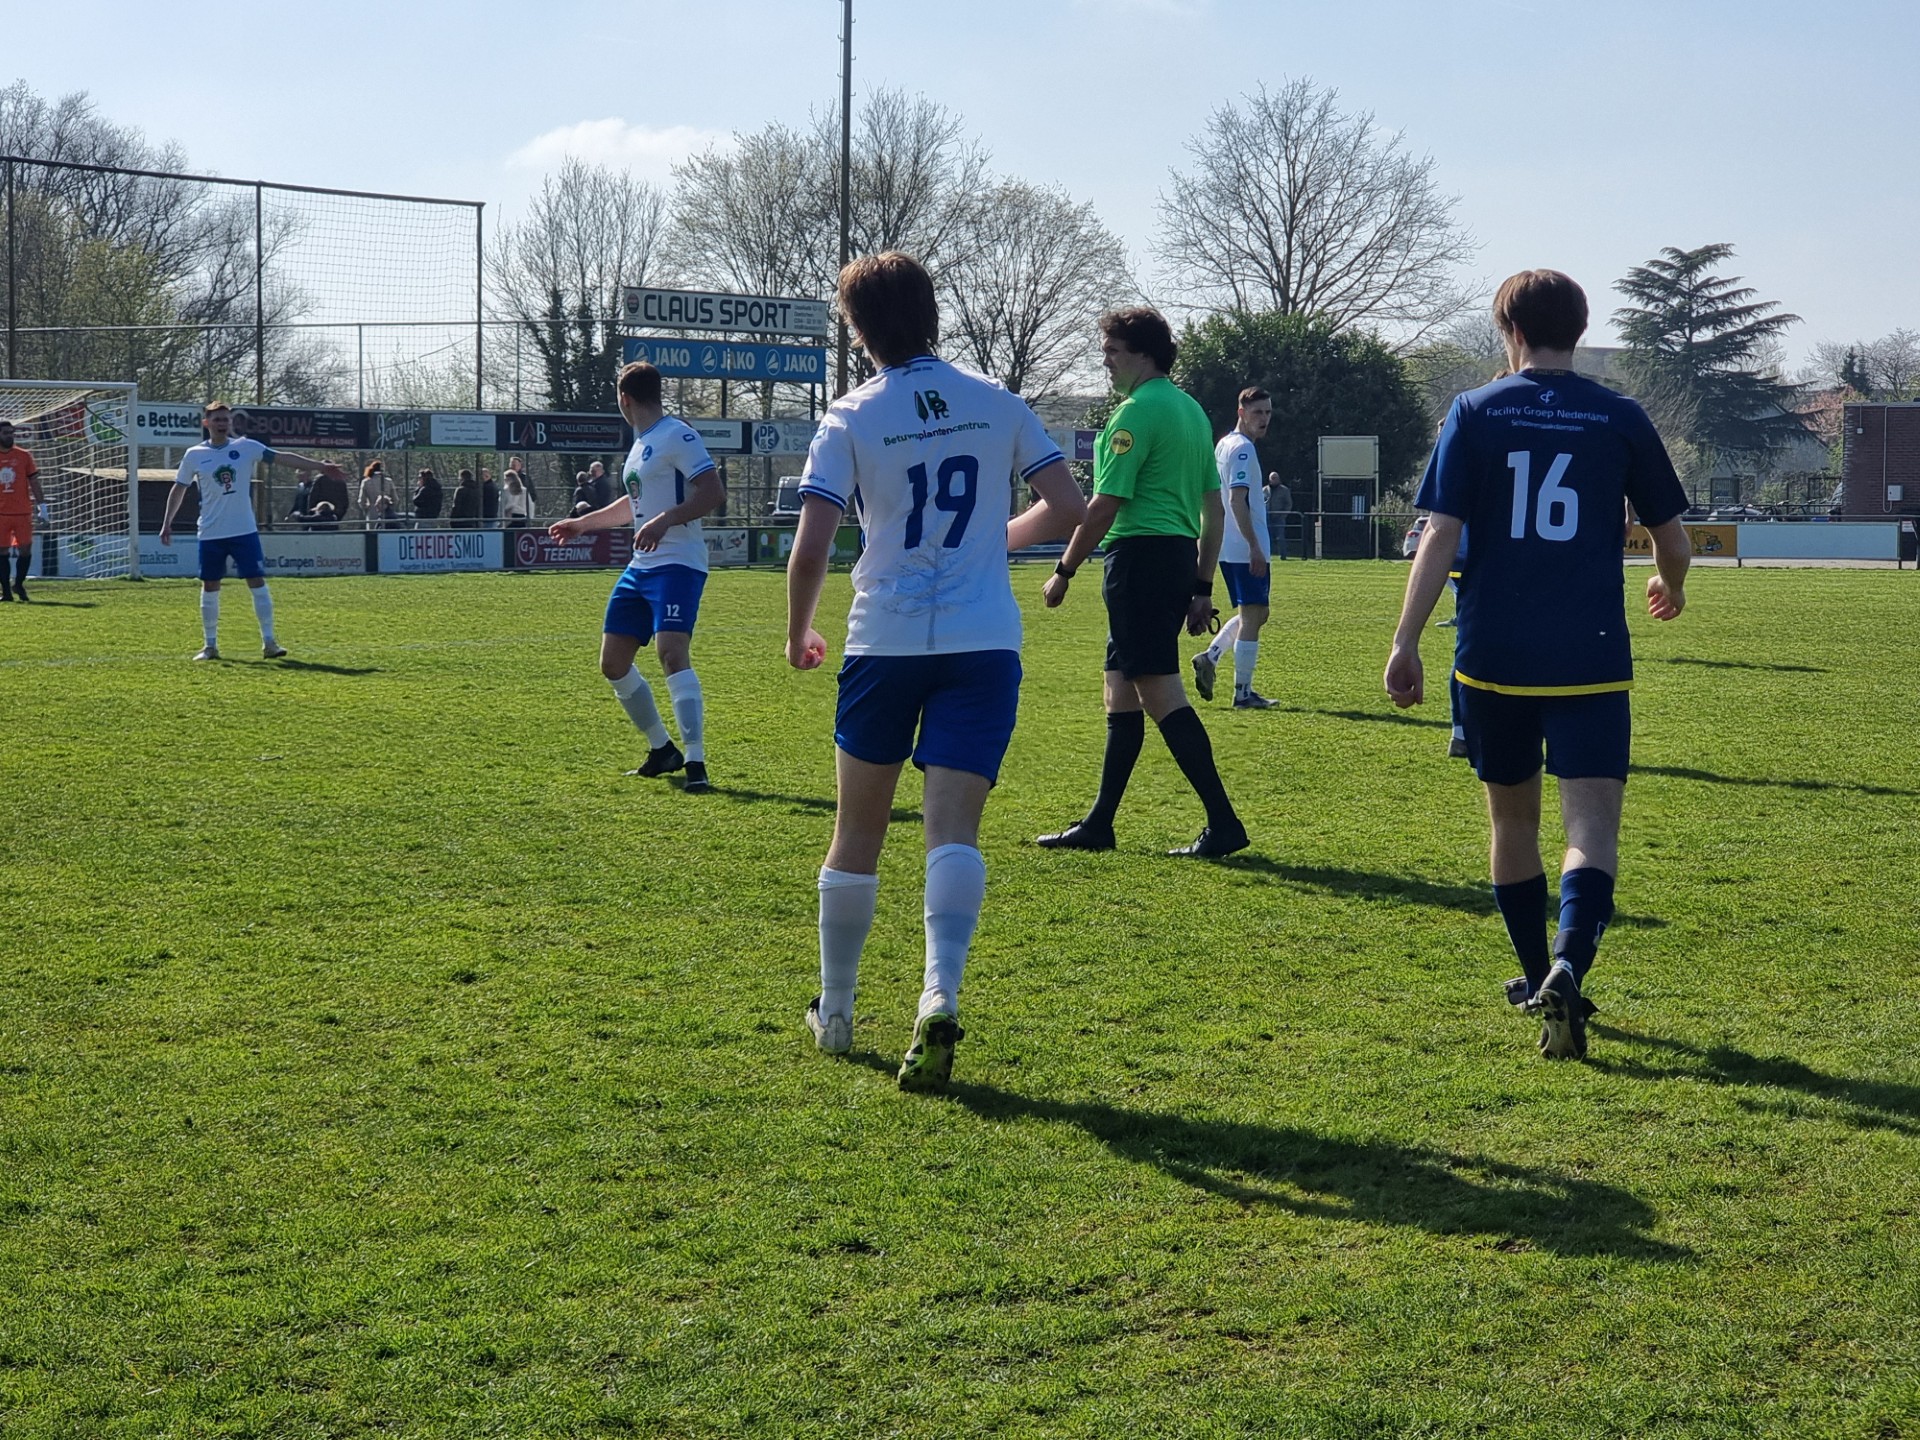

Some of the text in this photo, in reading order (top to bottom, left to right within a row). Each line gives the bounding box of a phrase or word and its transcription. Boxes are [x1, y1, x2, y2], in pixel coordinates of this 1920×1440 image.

[643, 294, 714, 324] CLAUS
[718, 299, 791, 329] SPORT
[653, 347, 691, 368] JAKO
[720, 349, 756, 371] JAKO
[783, 354, 818, 374] JAKO
[1487, 406, 1609, 423] Facility Groep Nederland
[760, 426, 774, 437] DP
[883, 421, 990, 446] Betuwsplantencentrum
[904, 455, 979, 550] 19
[1507, 450, 1578, 542] 16
[399, 534, 484, 560] DEHEIDESMID
[543, 547, 593, 561] TEERINK
[279, 556, 317, 571] Campen
[318, 556, 362, 569] Bouwgroep
[666, 604, 680, 617] 12
